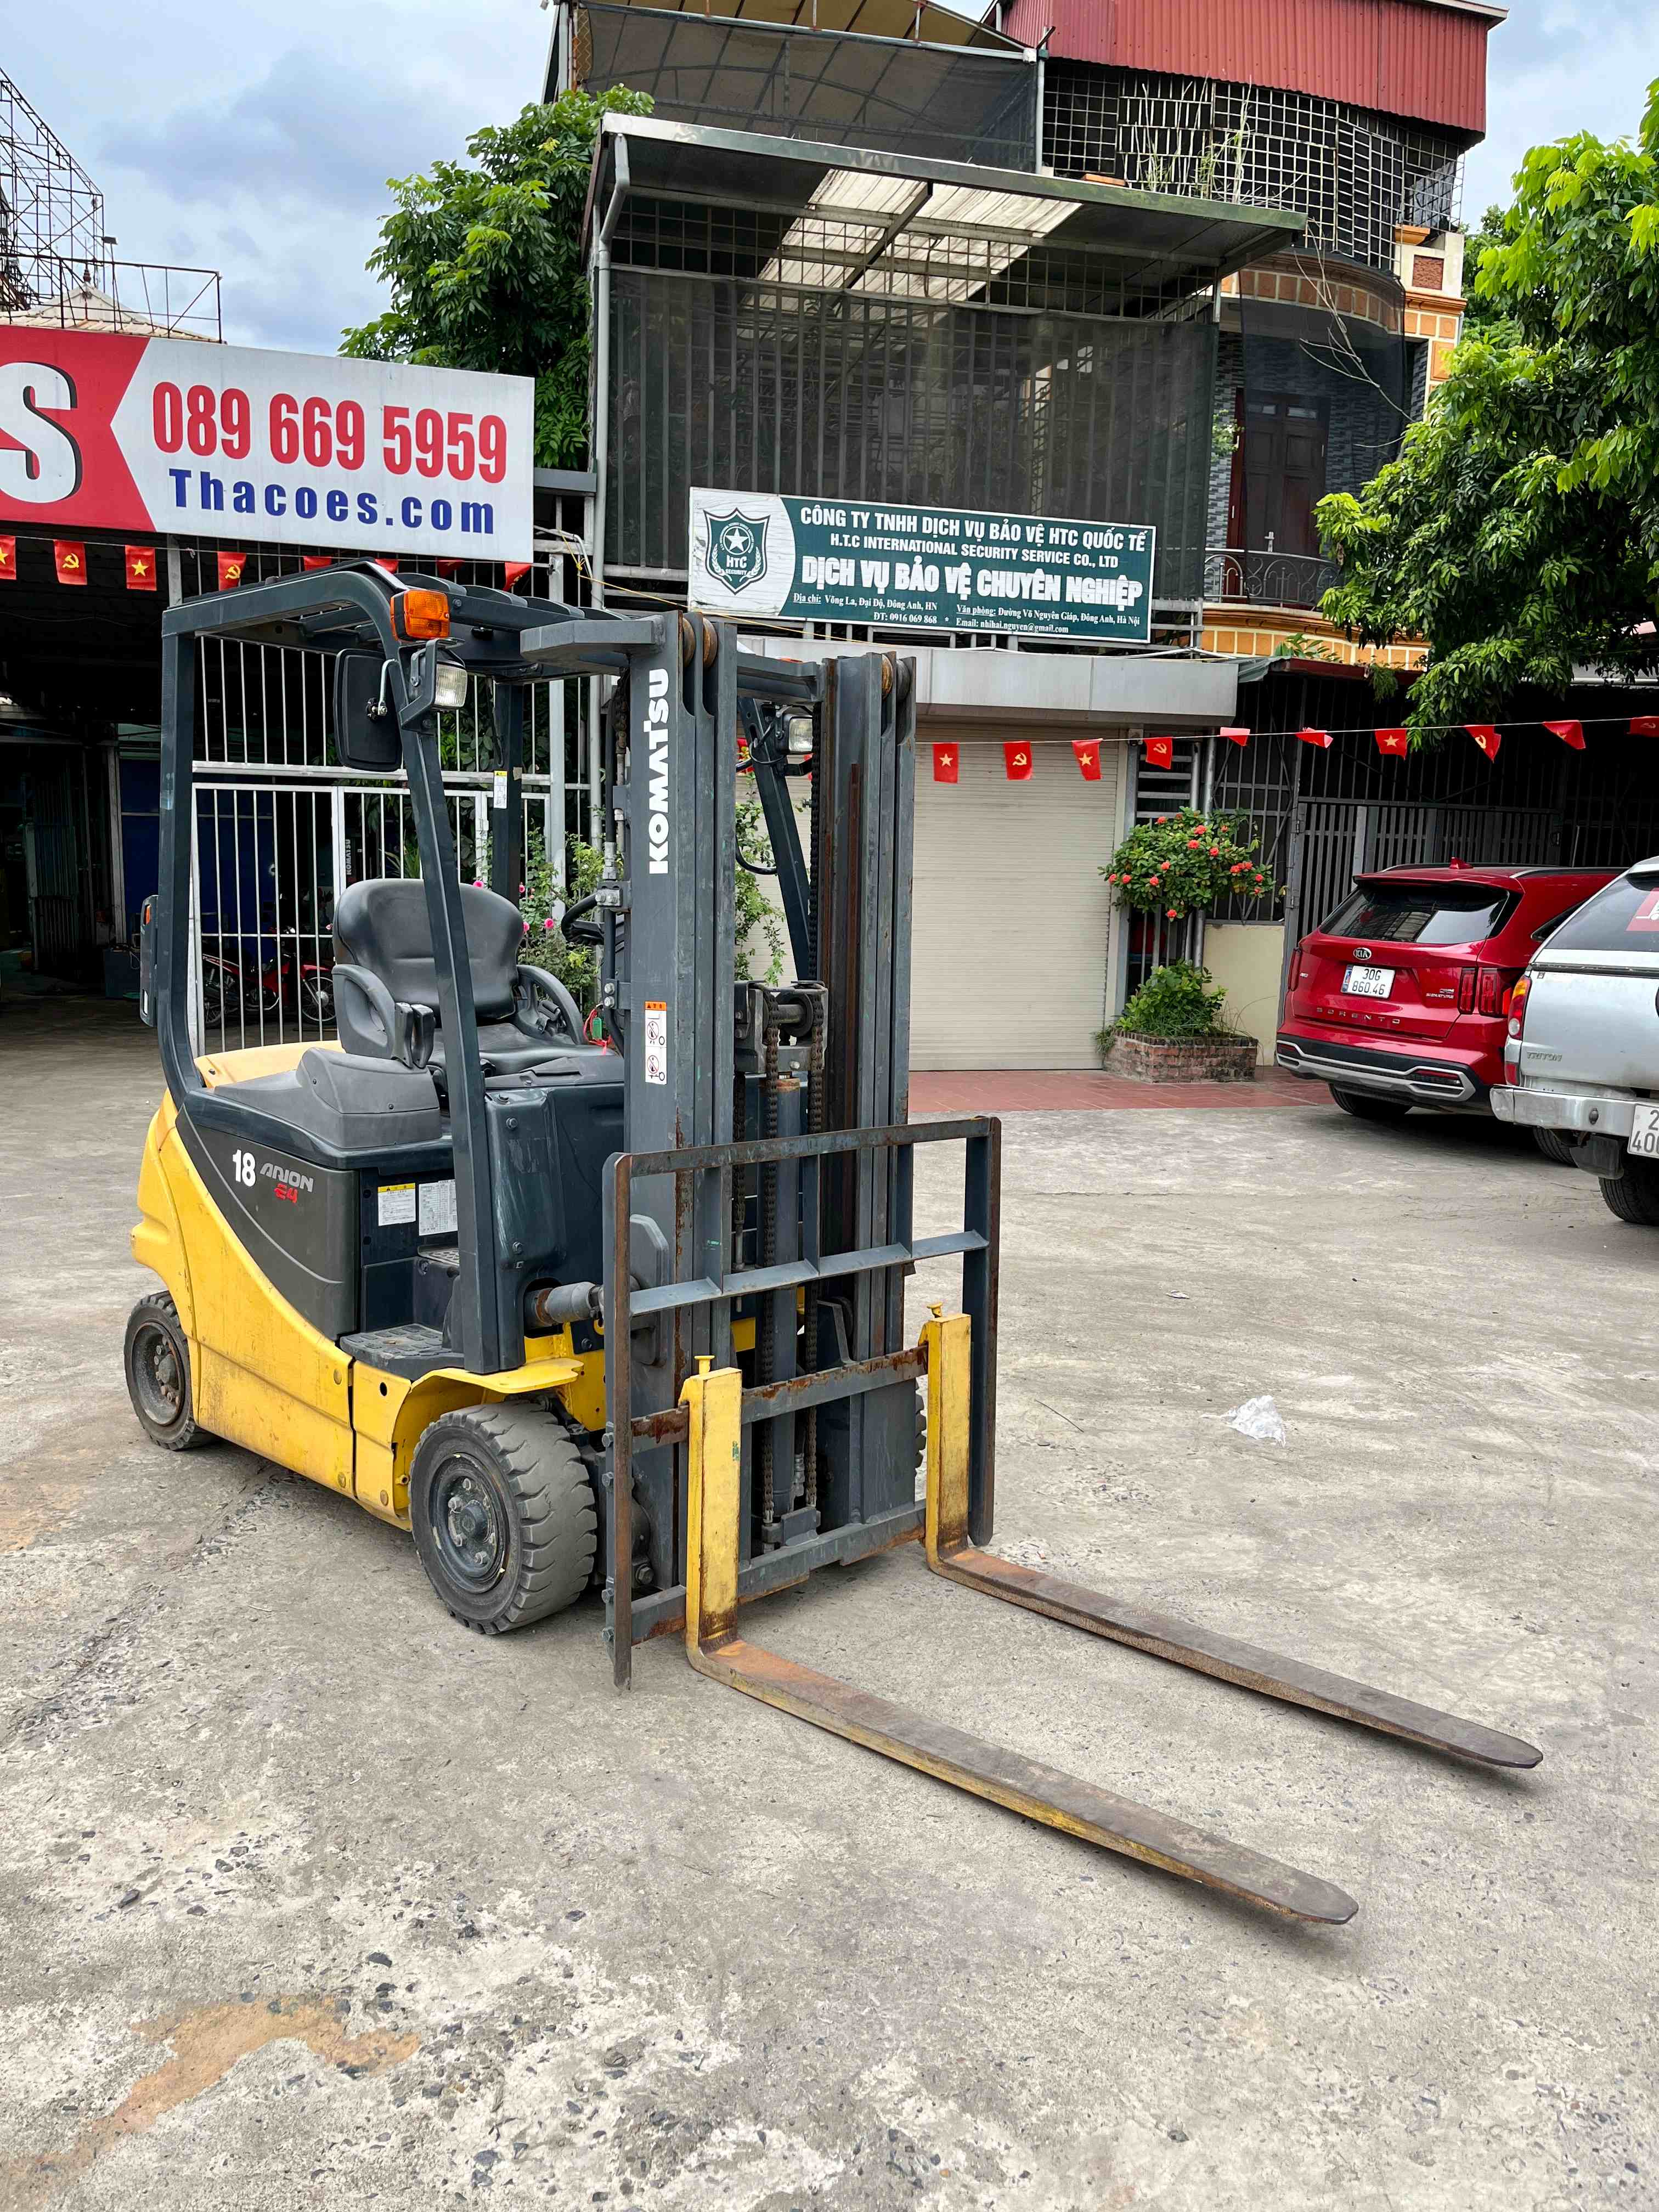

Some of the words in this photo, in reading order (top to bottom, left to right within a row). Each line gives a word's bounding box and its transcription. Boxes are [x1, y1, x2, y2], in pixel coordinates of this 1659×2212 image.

[0, 362, 82, 504] S
[153, 381, 251, 460] 089
[269, 393, 365, 471] 669
[383, 405, 507, 484] 5959
[169, 468, 494, 534] Thacoes.com
[800, 504, 847, 527] CÔNG
[850, 511, 870, 528] TY
[874, 512, 917, 533] TNHH
[922, 516, 960, 538] DỊCH
[964, 520, 985, 542] VỤ
[989, 518, 1022, 541] BẢO
[1025, 523, 1045, 547] VỆ
[1048, 527, 1079, 546] HTC
[1082, 527, 1124, 550] QUỐC
[1128, 529, 1148, 552] TẾ
[726, 555, 748, 569] HTC
[830, 533, 860, 548] H.T.C
[864, 536, 958, 556] INTERNATIONAL
[961, 543, 1018, 560] SECURITY
[1021, 549, 1070, 565] SERVICE
[1073, 554, 1096, 568] CO.,
[1098, 556, 1119, 568] LTD
[802, 555, 855, 590] DỊCH
[860, 560, 890, 594] VỤ
[894, 555, 940, 592] BẢO
[944, 562, 972, 601] VỆ
[977, 568, 1061, 602] CHUYÊN
[1065, 575, 1143, 612] NGHIỆP
[793, 592, 806, 604] Địa
[825, 594, 844, 606] Võng
[845, 597, 857, 606] La,
[859, 597, 871, 608] Đại
[906, 601, 924, 611] Anh,
[925, 601, 938, 611] HN
[956, 604, 970, 613] Văn
[1060, 611, 1079, 623] Giáp,
[1099, 614, 1115, 624] Anh,
[1116, 615, 1127, 624] Hà
[1128, 616, 1141, 627] Nội
[873, 612, 888, 621] ĐT:
[889, 613, 908, 623] 0916
[909, 614, 923, 623] 069
[923, 615, 938, 624] 868
[956, 618, 979, 627] Email:
[980, 619, 1069, 634] nhihai.nguyen@gmail.com
[643, 668, 669, 874] KOMATSU
[1355, 949, 1368, 958] KIA
[1352, 980, 1386, 995] 860.46
[1362, 968, 1381, 981] 30G
[233, 1149, 256, 1187] 18
[259, 1163, 314, 1193] ARION
